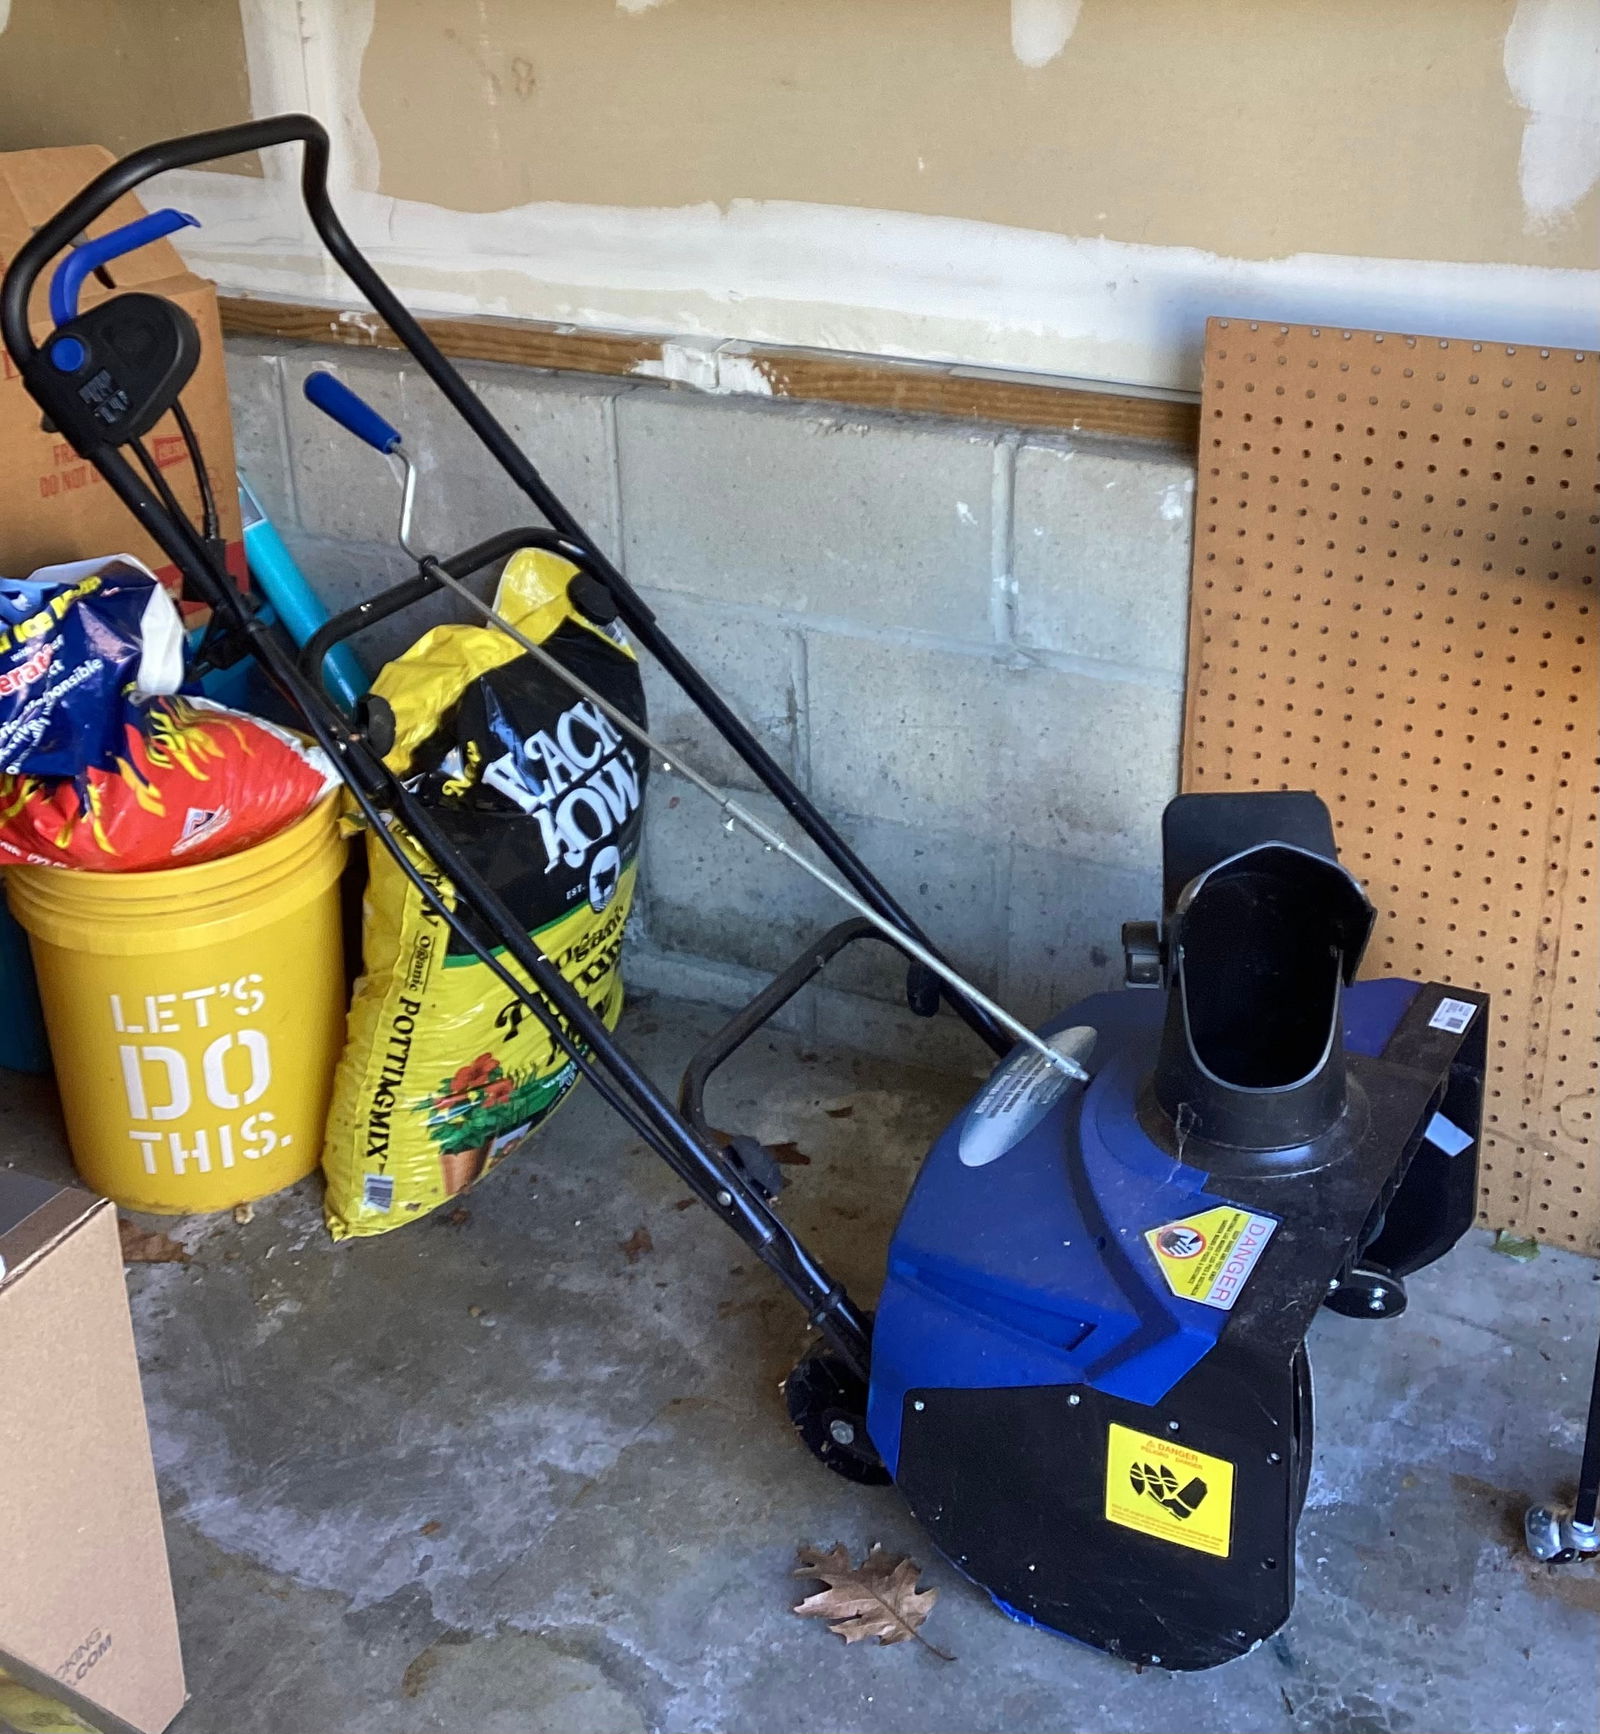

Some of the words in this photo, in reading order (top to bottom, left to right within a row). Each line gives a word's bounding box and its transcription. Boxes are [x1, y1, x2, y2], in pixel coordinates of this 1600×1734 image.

[110, 973, 264, 1034] LET'S
[119, 1029, 272, 1121] DO
[128, 1111, 293, 1175] THIS.
[1211, 1223, 1266, 1302] DANGER
[1158, 1443, 1199, 1462] DANGER
